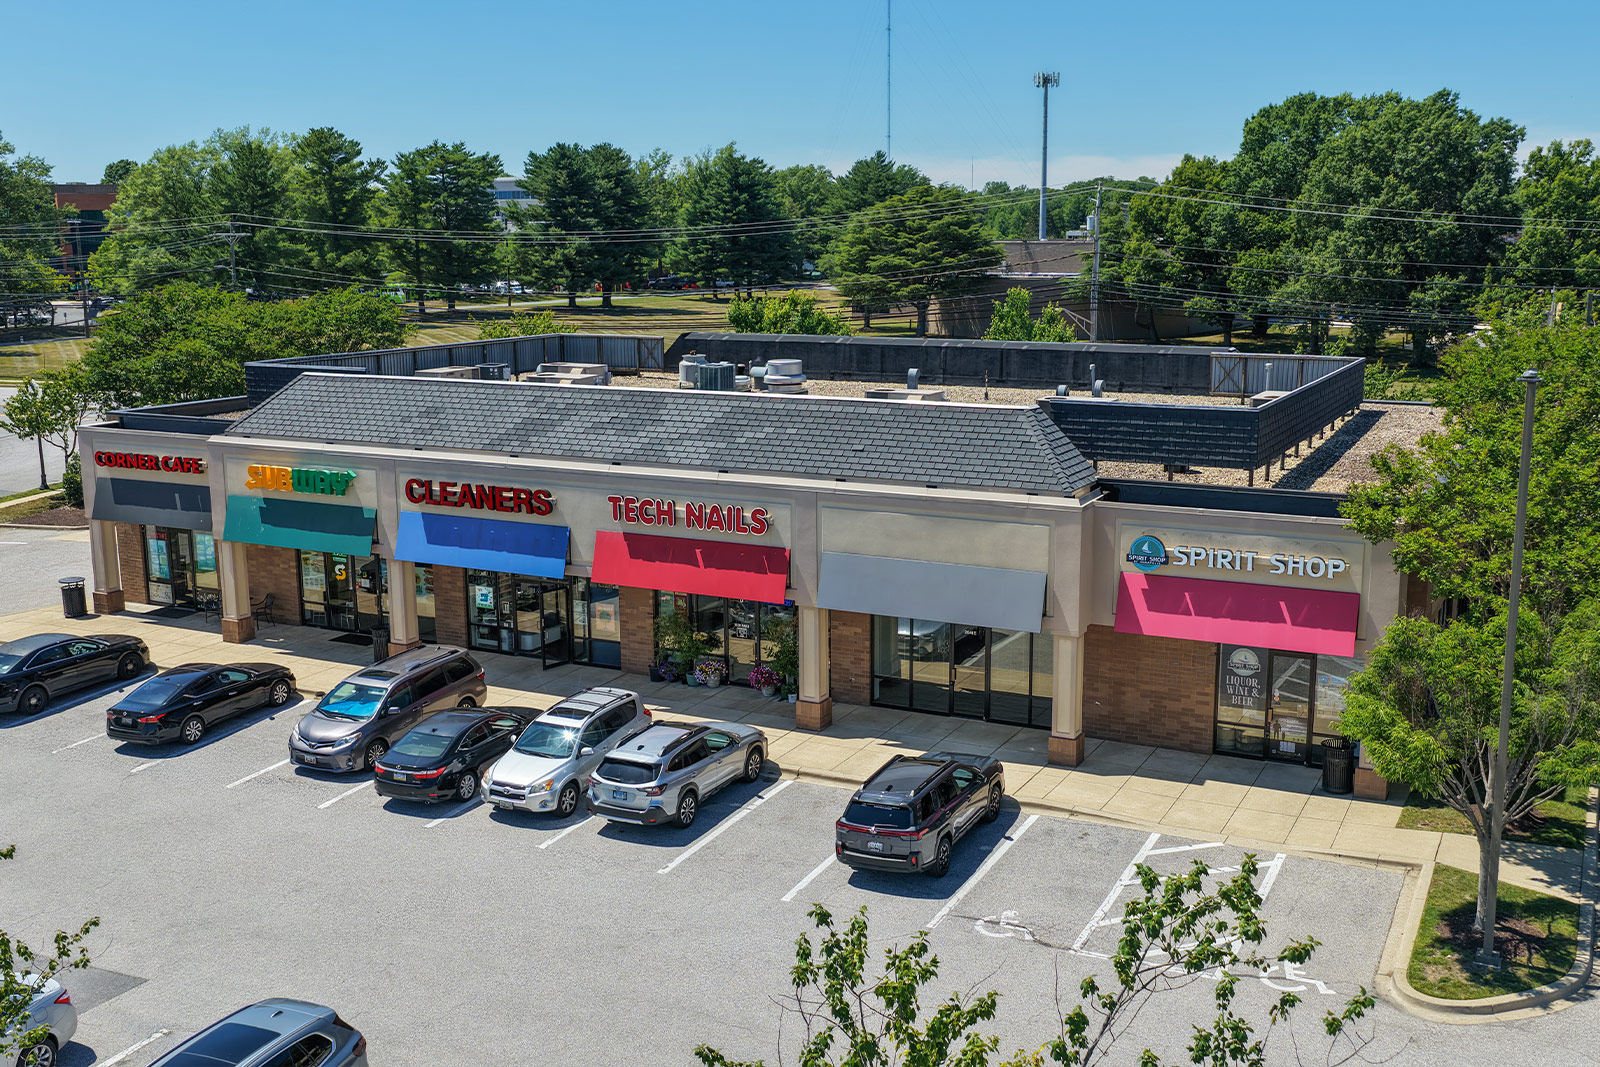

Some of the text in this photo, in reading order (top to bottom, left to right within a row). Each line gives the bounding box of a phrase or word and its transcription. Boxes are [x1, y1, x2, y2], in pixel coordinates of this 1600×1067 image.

[95, 450, 204, 474] CORNER CAFE
[245, 464, 356, 497] SUBWAY
[405, 478, 553, 516] CLEANERS
[607, 495, 769, 536] TECH NAILS
[1128, 554, 1148, 562] SPIRIT
[1172, 545, 1346, 579] SPIRIT SHOP
[1226, 675, 1261, 689] LIQUOR,
[1226, 685, 1260, 698] WINE &
[1232, 695, 1253, 706] BEER
